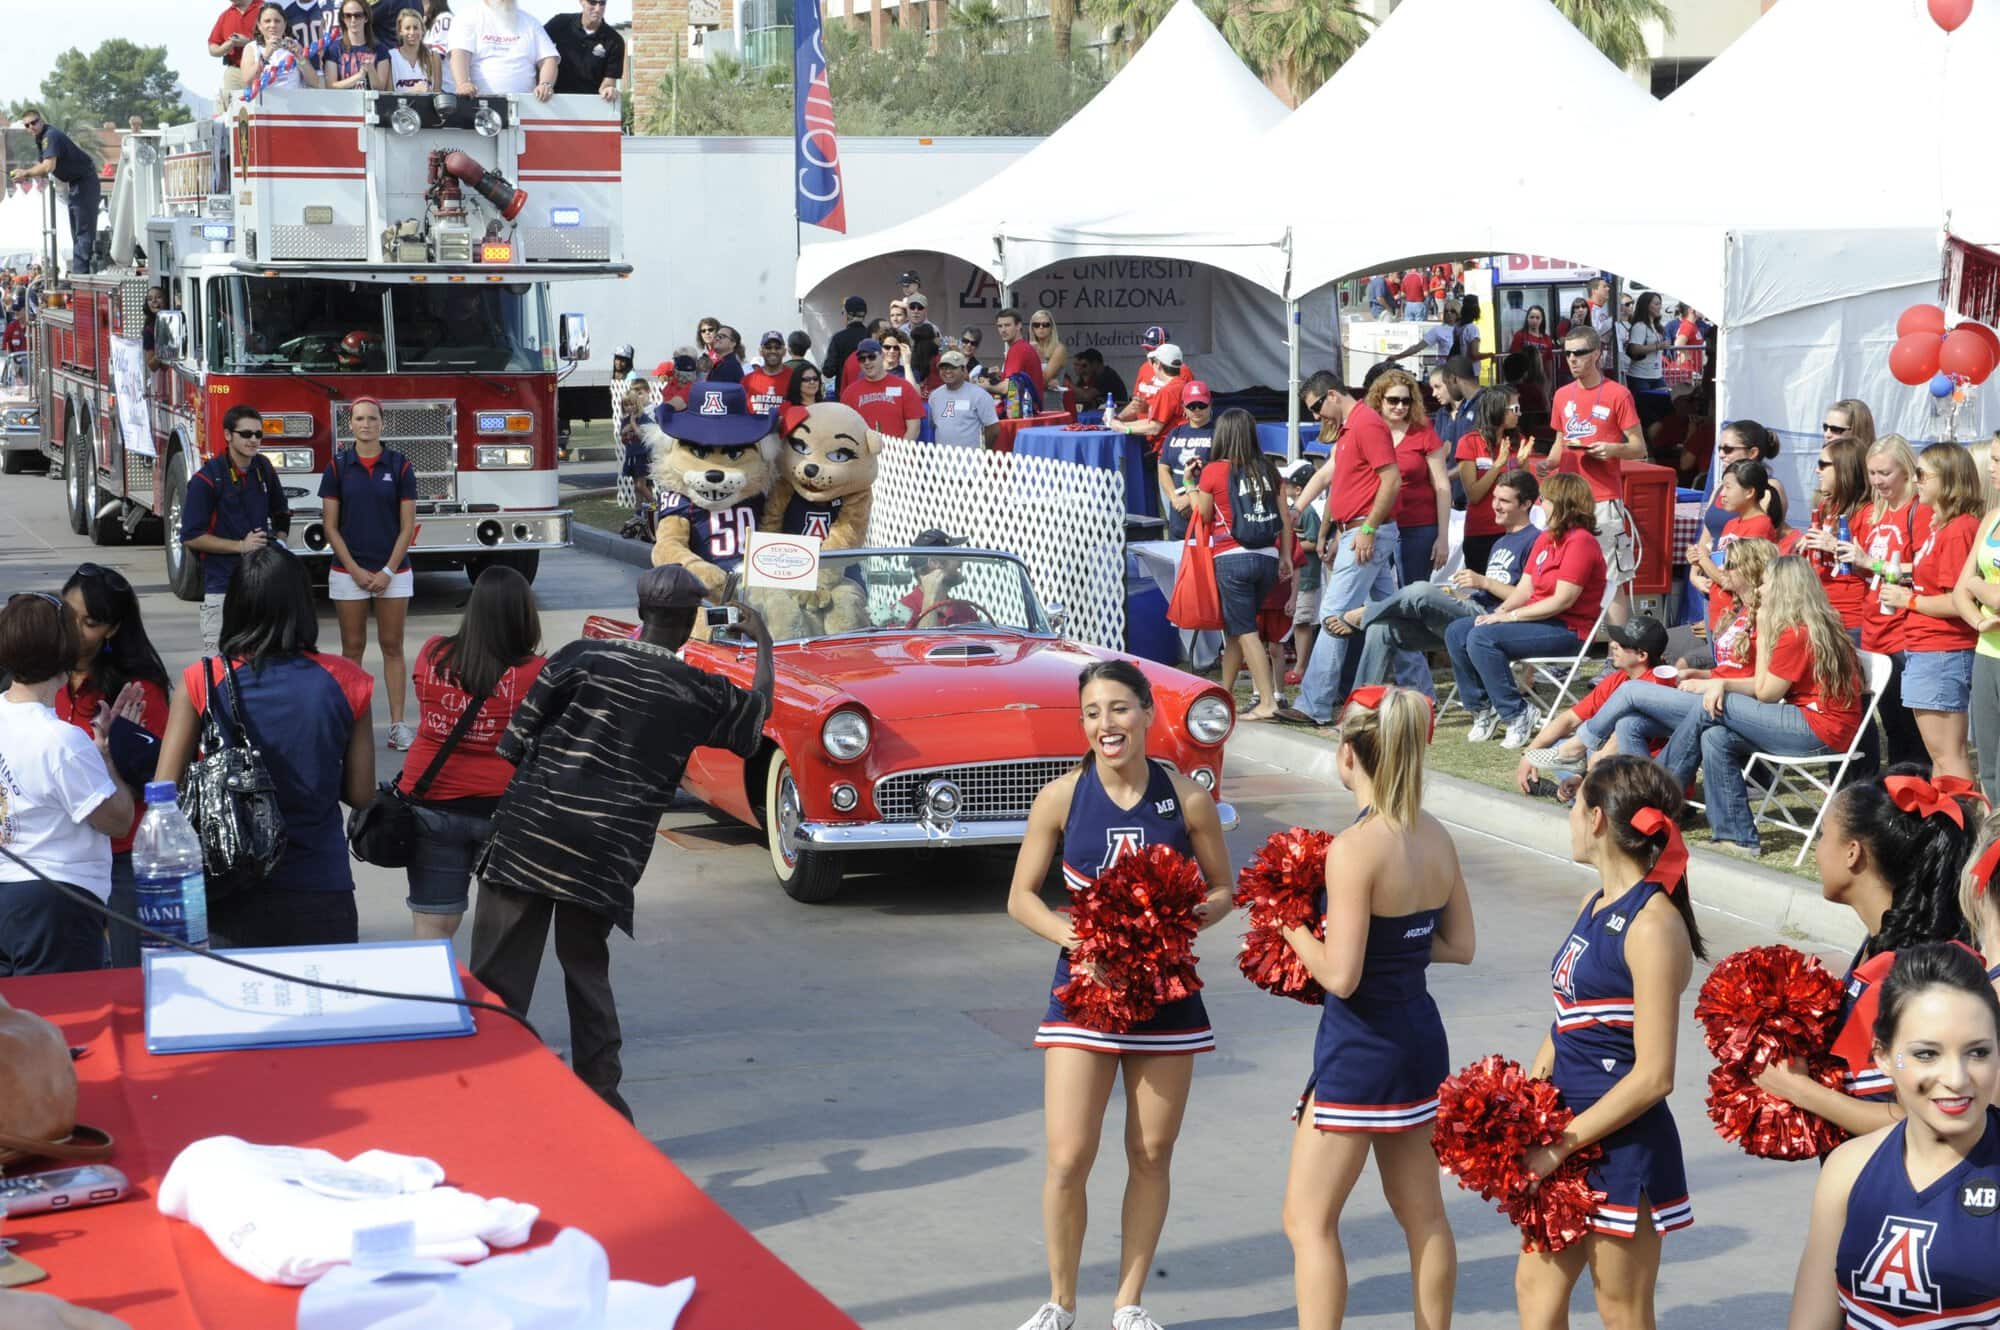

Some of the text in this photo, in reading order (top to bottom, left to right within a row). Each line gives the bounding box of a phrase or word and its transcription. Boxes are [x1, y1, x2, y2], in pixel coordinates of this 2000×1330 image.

[1073, 259, 1195, 280] UNIVERSITY
[1039, 287, 1178, 308] OF ARIZONA
[1086, 328, 1152, 347] Medicin
[700, 391, 728, 416] A
[750, 395, 783, 403] ARIZON
[660, 491, 681, 511] 50
[709, 507, 755, 557] 50
[441, 693, 488, 717] CLAS
[1155, 799, 1175, 815] MB
[1606, 914, 1627, 933] MB
[1551, 934, 1590, 1003] A
[1963, 1188, 1997, 1208] MB
[1851, 1215, 1942, 1315] A
